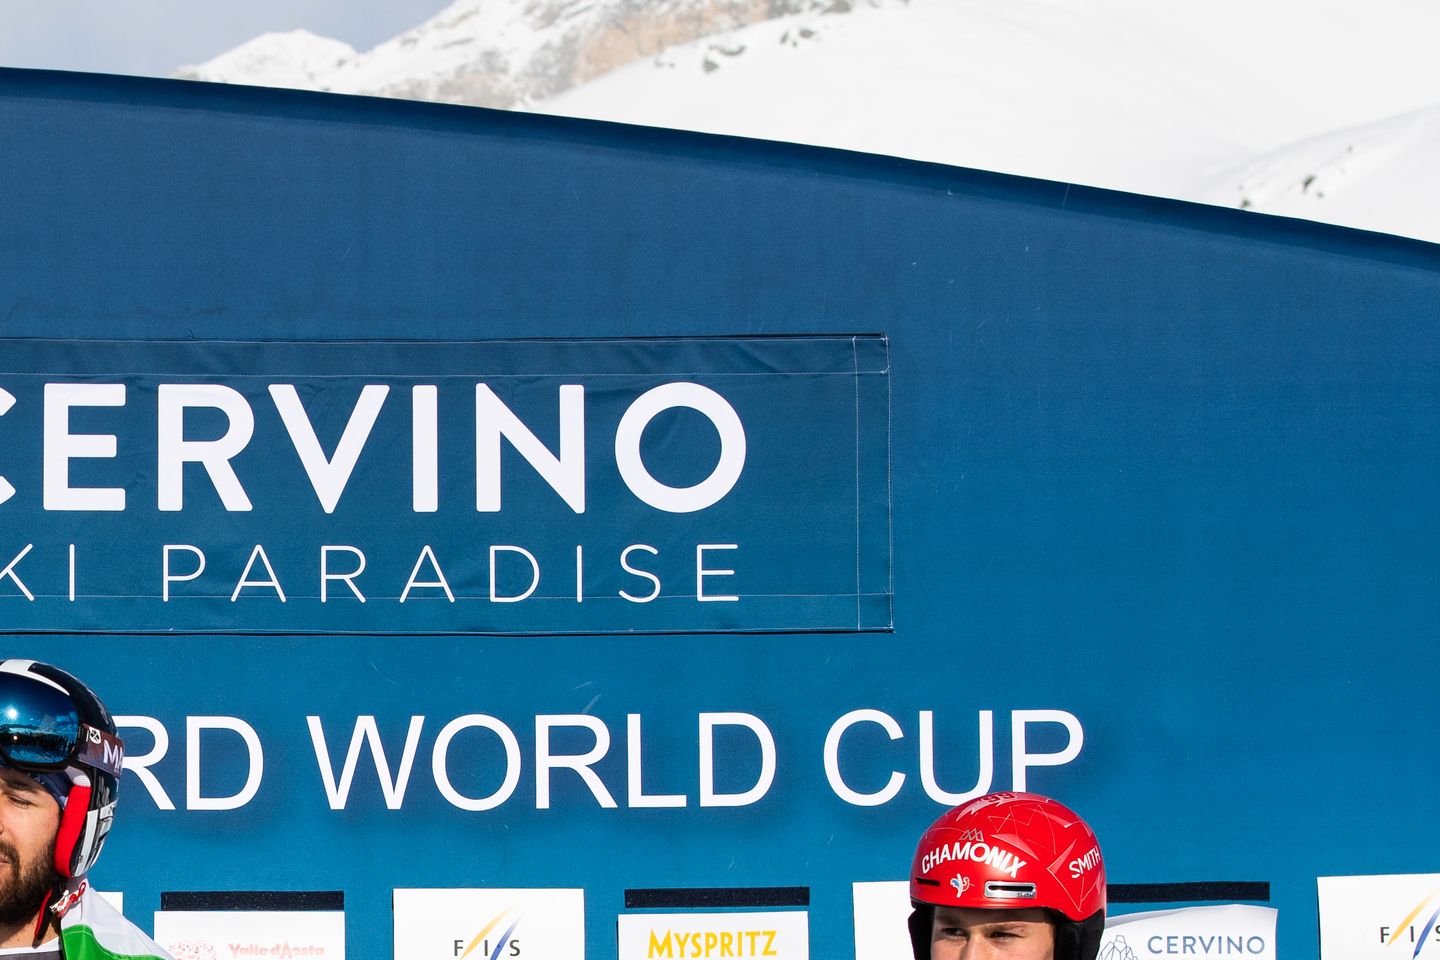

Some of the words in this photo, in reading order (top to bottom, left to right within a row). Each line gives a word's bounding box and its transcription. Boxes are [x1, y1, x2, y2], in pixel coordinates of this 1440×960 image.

[163, 543, 740, 604] PARADISE
[306, 712, 778, 812] WORLD
[822, 708, 1085, 811] CUP
[922, 842, 1027, 878] CHAMONIX
[1069, 845, 1101, 879] SMITH
[228, 943, 269, 958] Valle
[454, 940, 521, 957] FIS
[647, 928, 777, 958] MYSPRITZ
[1148, 935, 1266, 955] CERVINO
